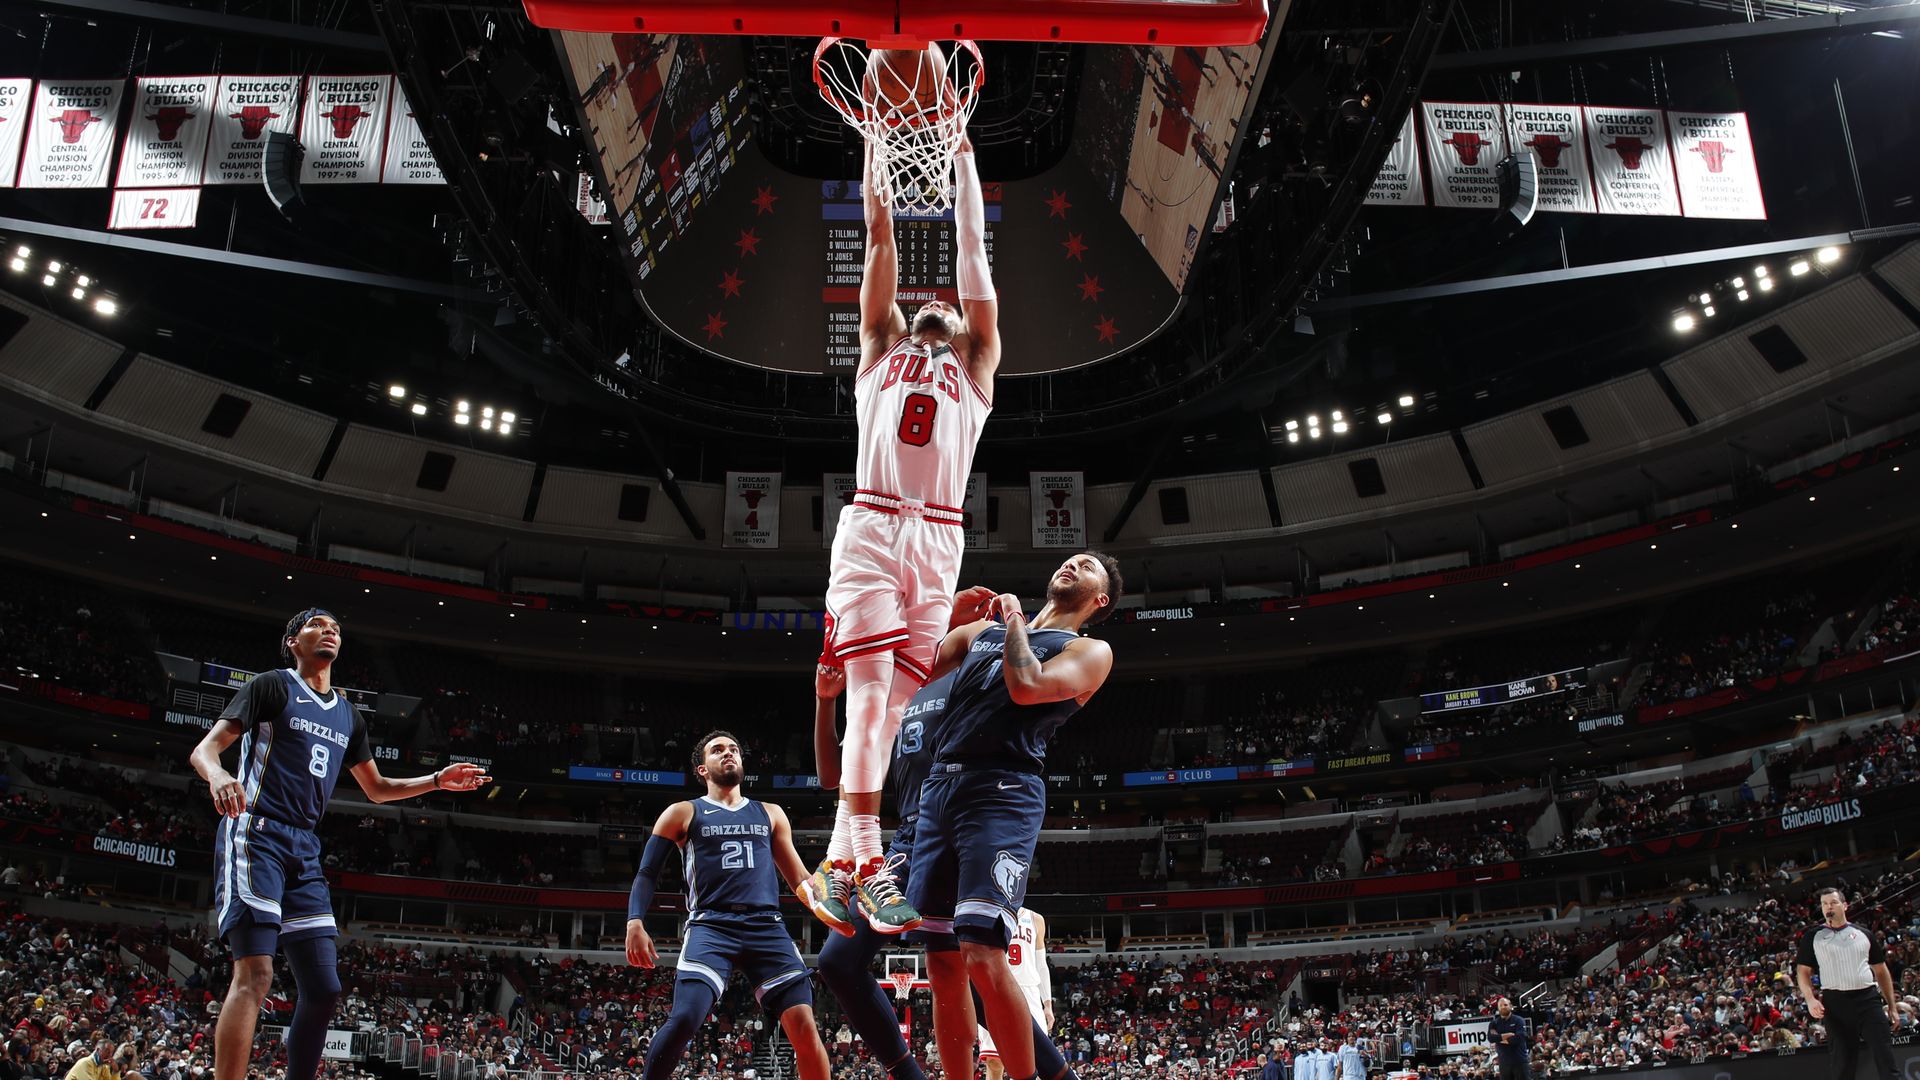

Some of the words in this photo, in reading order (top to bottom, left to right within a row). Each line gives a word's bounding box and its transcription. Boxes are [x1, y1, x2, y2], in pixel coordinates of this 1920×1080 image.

[49, 86, 112, 96] CHICAGO
[146, 84, 206, 94] CHICAGO
[228, 83, 291, 92] CHICAGO
[319, 82, 379, 91] CHICAGO
[57, 98, 100, 107] BULLS
[153, 96, 195, 105] BULLS
[237, 94, 280, 104] BULLS
[327, 94, 369, 103] BULLS
[1434, 109, 1493, 120] CHICAGO
[1515, 111, 1572, 122] CHICAGO
[1596, 114, 1653, 124] CHICAGO
[1445, 121, 1486, 131] BULLS
[1680, 117, 1736, 128] CHICAGO
[1526, 123, 1566, 133] BULLS
[1608, 125, 1647, 135] BULLS
[1690, 129, 1730, 138] BULLS
[51, 145, 88, 153] CENTRAL
[147, 142, 183, 150] CENTRAL
[231, 141, 265, 150] CENTRA
[323, 141, 359, 149] CENTRAL
[144, 152, 183, 160] DIVISION
[228, 151, 263, 160] DIVISIO
[320, 151, 359, 159] DIVISION
[410, 151, 434, 159] DIVIS
[40, 164, 93, 172] CHAMPIONS
[137, 161, 187, 170] CHAMPIONS
[220, 161, 262, 170] CHAMPIO
[312, 161, 365, 169] CHAMPIONS
[402, 161, 438, 169] CHAMPI
[317, 171, 357, 179] 1997-98
[1455, 167, 1489, 175] EASTERN
[1377, 173, 1407, 181] ERENCE
[1447, 176, 1499, 185] CONFERENCE
[1617, 172, 1650, 180] EASTERN
[1539, 177, 1578, 186] NFERENCE
[1449, 185, 1499, 194] CHAMPIONS
[1539, 187, 1579, 196] AMPIONS
[140, 198, 169, 219] 72
[835, 230, 859, 238] TILLMAN
[898, 231, 903, 239] 2
[911, 231, 915, 239] 2
[923, 231, 927, 239] 2
[940, 231, 949, 239] 1/2
[834, 242, 863, 250] WILLIAMS
[923, 242, 927, 250] 4
[827, 253, 834, 261] 21
[834, 253, 853, 261] JONES
[923, 253, 927, 261] 2
[939, 253, 949, 261] 2/4
[911, 264, 915, 272] 7
[827, 275, 834, 283] 13
[835, 275, 861, 283] JACKSON
[923, 276, 927, 284] 7
[896, 292, 915, 300] ICAGO
[916, 292, 937, 300] BULLS
[835, 313, 859, 321] VUCEVIC
[828, 324, 834, 332] 11
[830, 336, 834, 344] 2
[835, 336, 849, 344] BALL
[826, 346, 834, 354] 44
[835, 346, 862, 355] WILLIAMS
[835, 358, 855, 366] LAVINE
[880, 353, 960, 403] BULS
[898, 392, 938, 447] 8
[744, 510, 758, 529] 4
[1046, 509, 1071, 527] 33
[1136, 609, 1166, 620] CHICAGO
[1166, 607, 1193, 620] BULLS
[735, 611, 824, 630] UNIT
[1509, 680, 1527, 690] KANE
[1445, 692, 1460, 701] KANE
[1460, 690, 1479, 699] BROWN
[1509, 685, 1535, 698] BROWN
[903, 698, 946, 719] ZZLIES
[165, 711, 184, 725] RUN
[184, 714, 201, 726] WITH
[201, 717, 214, 730] US
[1578, 719, 1596, 732] RUN
[1596, 716, 1612, 727] WITH
[1612, 714, 1624, 727] US
[290, 716, 350, 749] GRIZZLIES
[375, 746, 399, 760] 8:59
[309, 743, 330, 778] 8
[450, 754, 478, 763] MINNESOTA
[1327, 759, 1344, 770] FAST
[1344, 757, 1366, 768] BREAK
[1366, 753, 1391, 765] POINTS
[631, 771, 659, 782] CLUB
[1183, 770, 1212, 780] CLUB
[1781, 808, 1822, 830] CHICAGO
[1822, 798, 1861, 825] BULLS
[701, 824, 769, 837] GRIZZLIES
[93, 836, 137, 856] CHICAGO
[137, 844, 176, 867] BULLS
[720, 841, 755, 869] 21
[1008, 944, 1022, 965] 9
[1458, 1028, 1487, 1045] imp
[325, 1040, 347, 1050] cate
